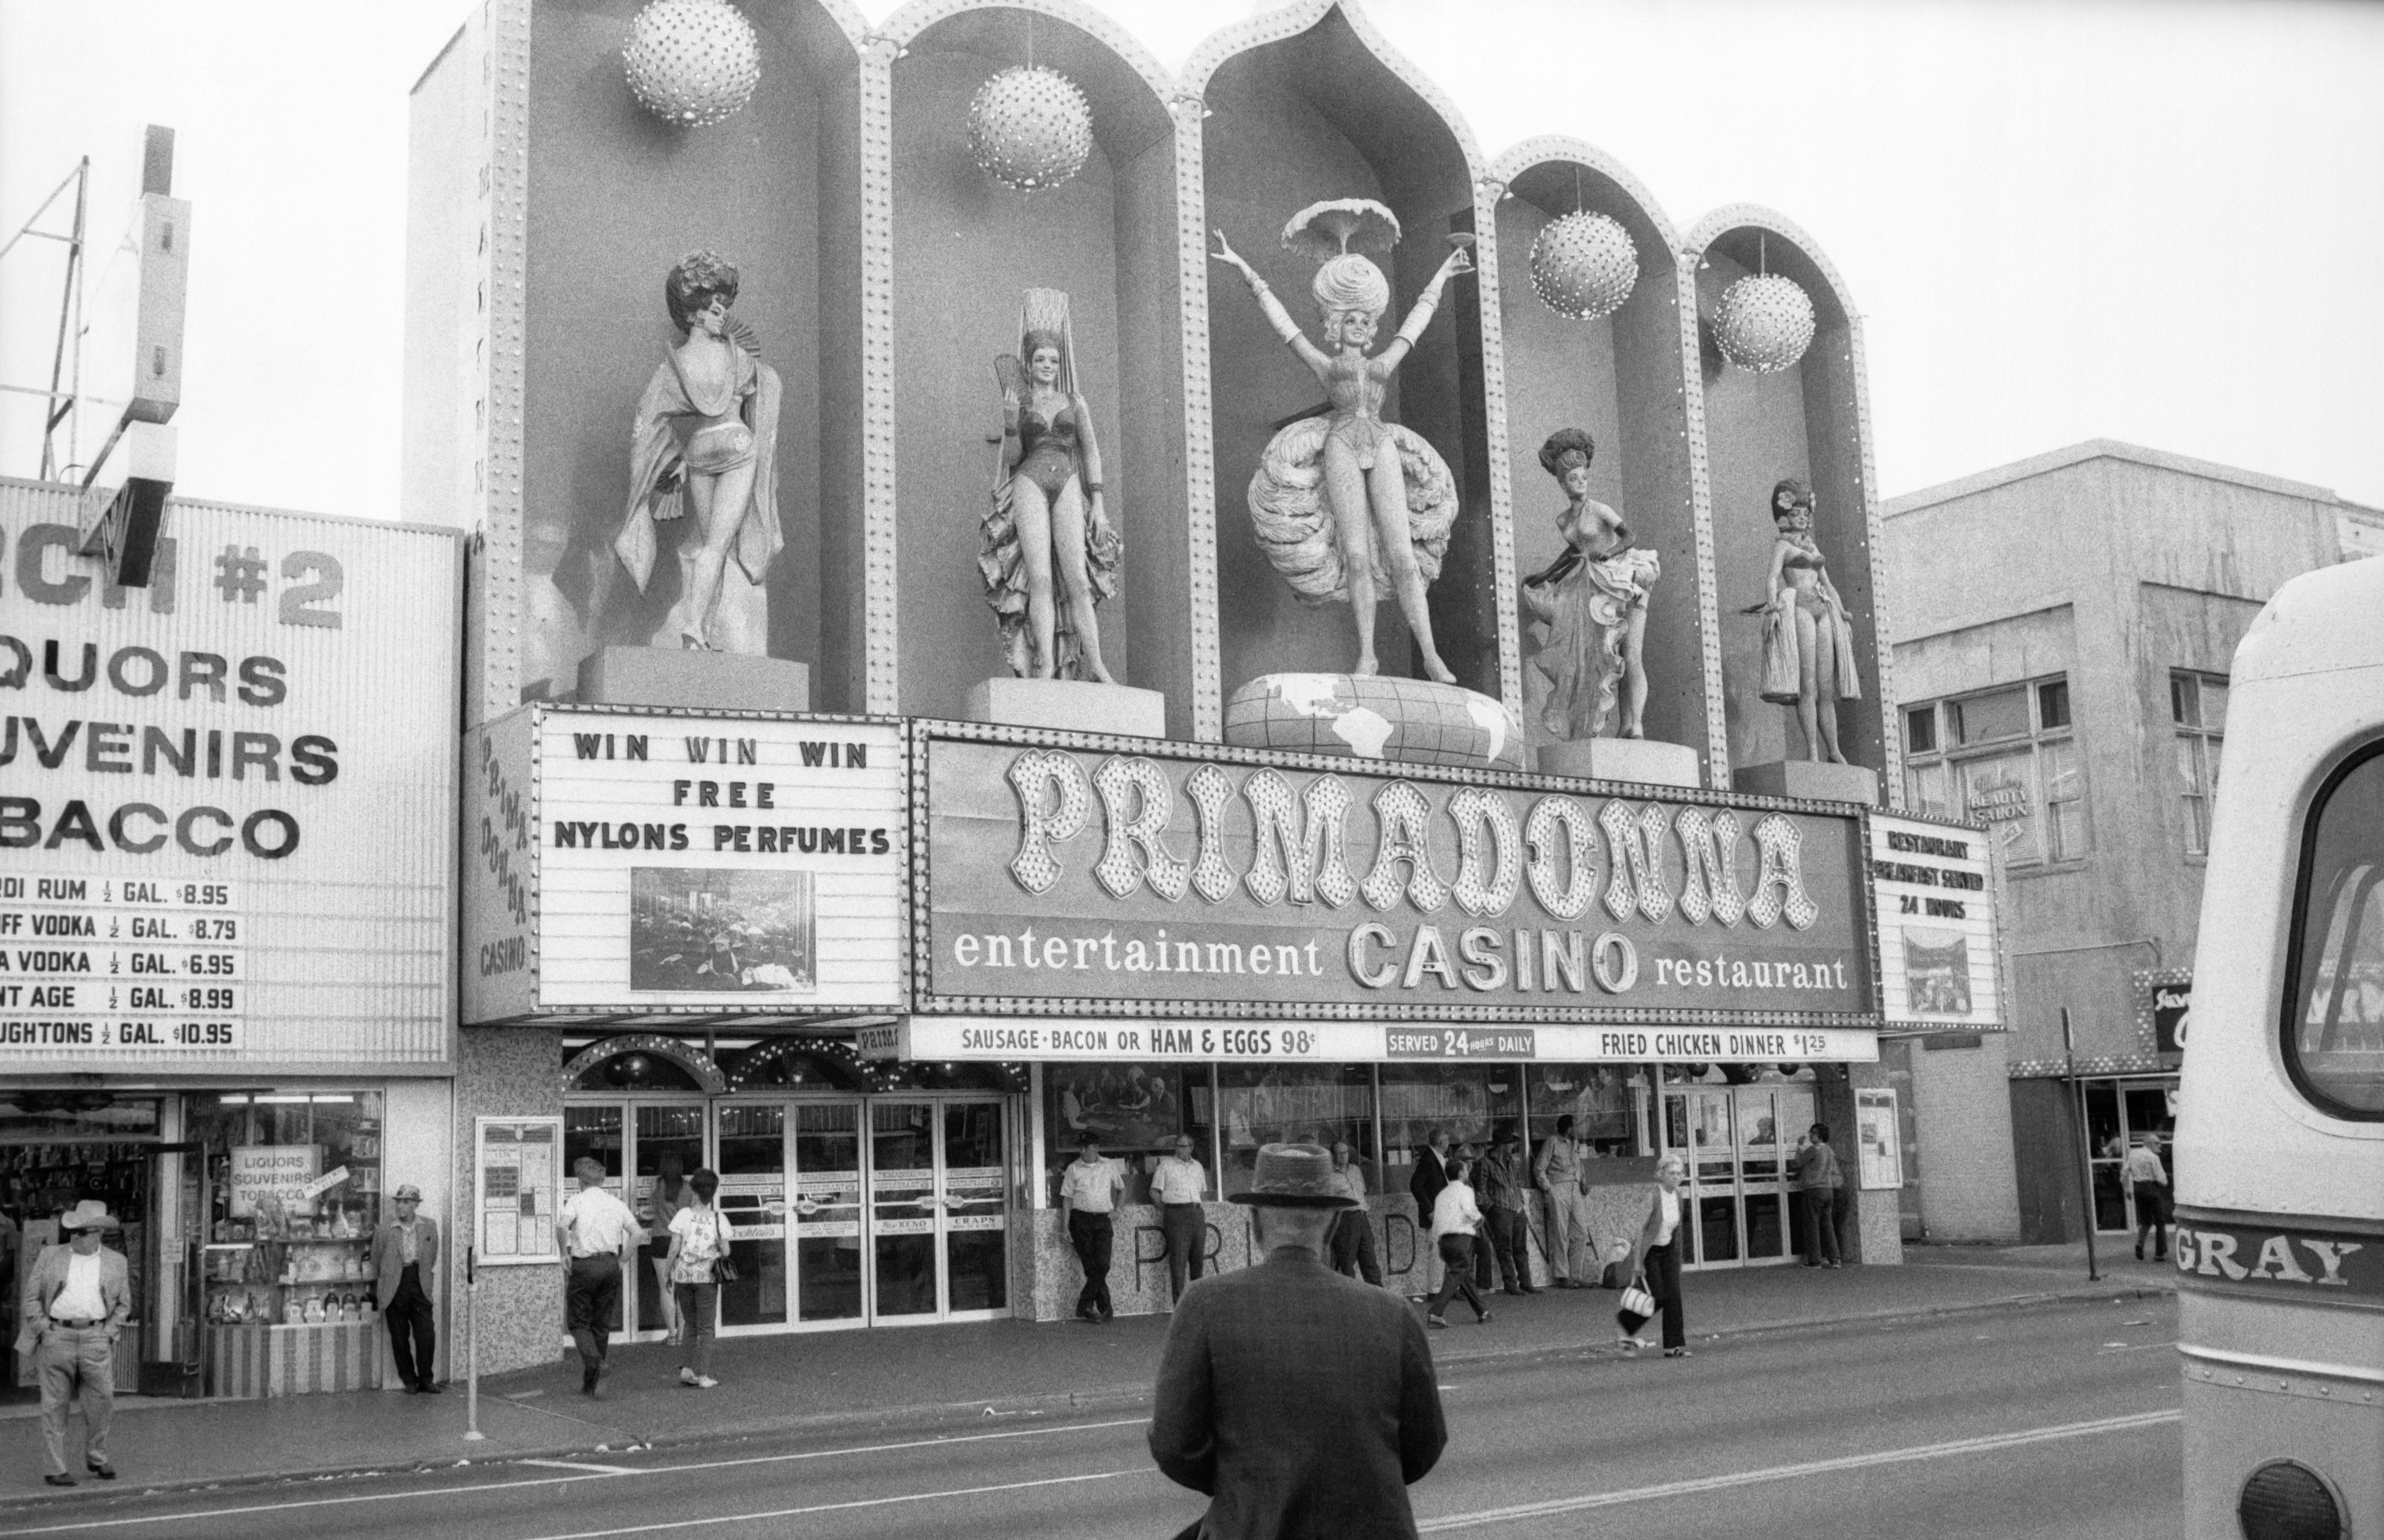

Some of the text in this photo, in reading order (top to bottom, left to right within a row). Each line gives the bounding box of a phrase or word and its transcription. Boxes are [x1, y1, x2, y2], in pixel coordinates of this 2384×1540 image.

[214, 544, 343, 630] #2
[574, 732, 866, 769] WIN WIN WIN
[674, 780, 774, 809] FREE
[555, 821, 889, 855] NYLONS PERFUMES
[1009, 747, 1818, 931] PRIMADONNA
[38, 879, 86, 900] RUM
[124, 882, 168, 903] GAL.
[32, 914, 96, 937] VODKA
[132, 917, 177, 938] GAL.
[18, 951, 90, 972] VODKA
[131, 953, 176, 974] GAL.
[481, 935, 525, 977] CASINO
[954, 922, 1848, 994] entertainment CASINO restaurant
[30, 986, 75, 1007] AGE
[130, 988, 174, 1008] GAL.
[120, 1023, 165, 1044] GAL.
[1051, 1030, 1108, 1050] BACON
[1118, 1031, 1141, 1051] OR
[1151, 1029, 1193, 1054] HAM
[1201, 1030, 1216, 1053] &
[1223, 1029, 1272, 1054] EGGS
[1389, 1030, 1533, 1055] SERVED 24 HOURS DAILY
[1602, 1034, 1647, 1055] FRIED
[1656, 1034, 1721, 1055] CHICKEN
[1730, 1034, 1786, 1055] DINNER
[245, 1157, 304, 1168] LIQUORS
[232, 1173, 313, 1185] SOUVENIRS
[2176, 1228, 2363, 1285] GRAY
